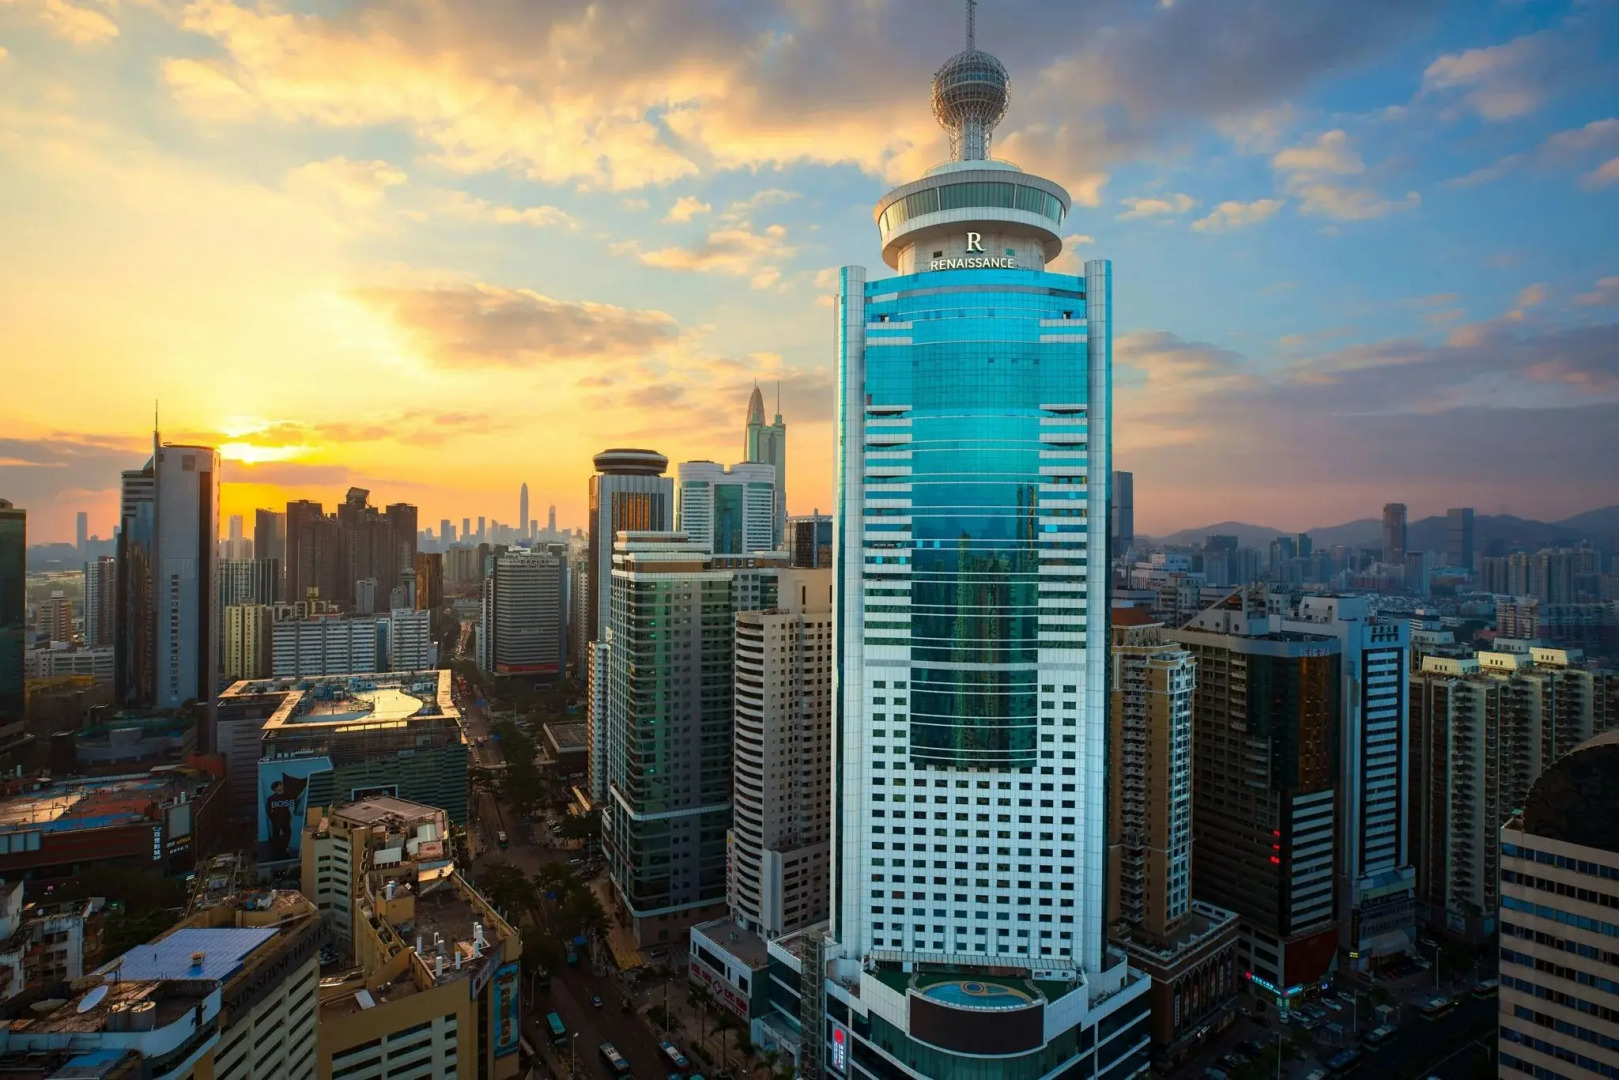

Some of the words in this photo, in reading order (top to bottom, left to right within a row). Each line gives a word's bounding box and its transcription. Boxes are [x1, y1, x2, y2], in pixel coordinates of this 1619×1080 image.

[966, 232, 986, 251] R
[930, 257, 1015, 271] RENAISSANCE
[271, 799, 295, 808] BOSS
[230, 951, 292, 1012] SUNSHINE
